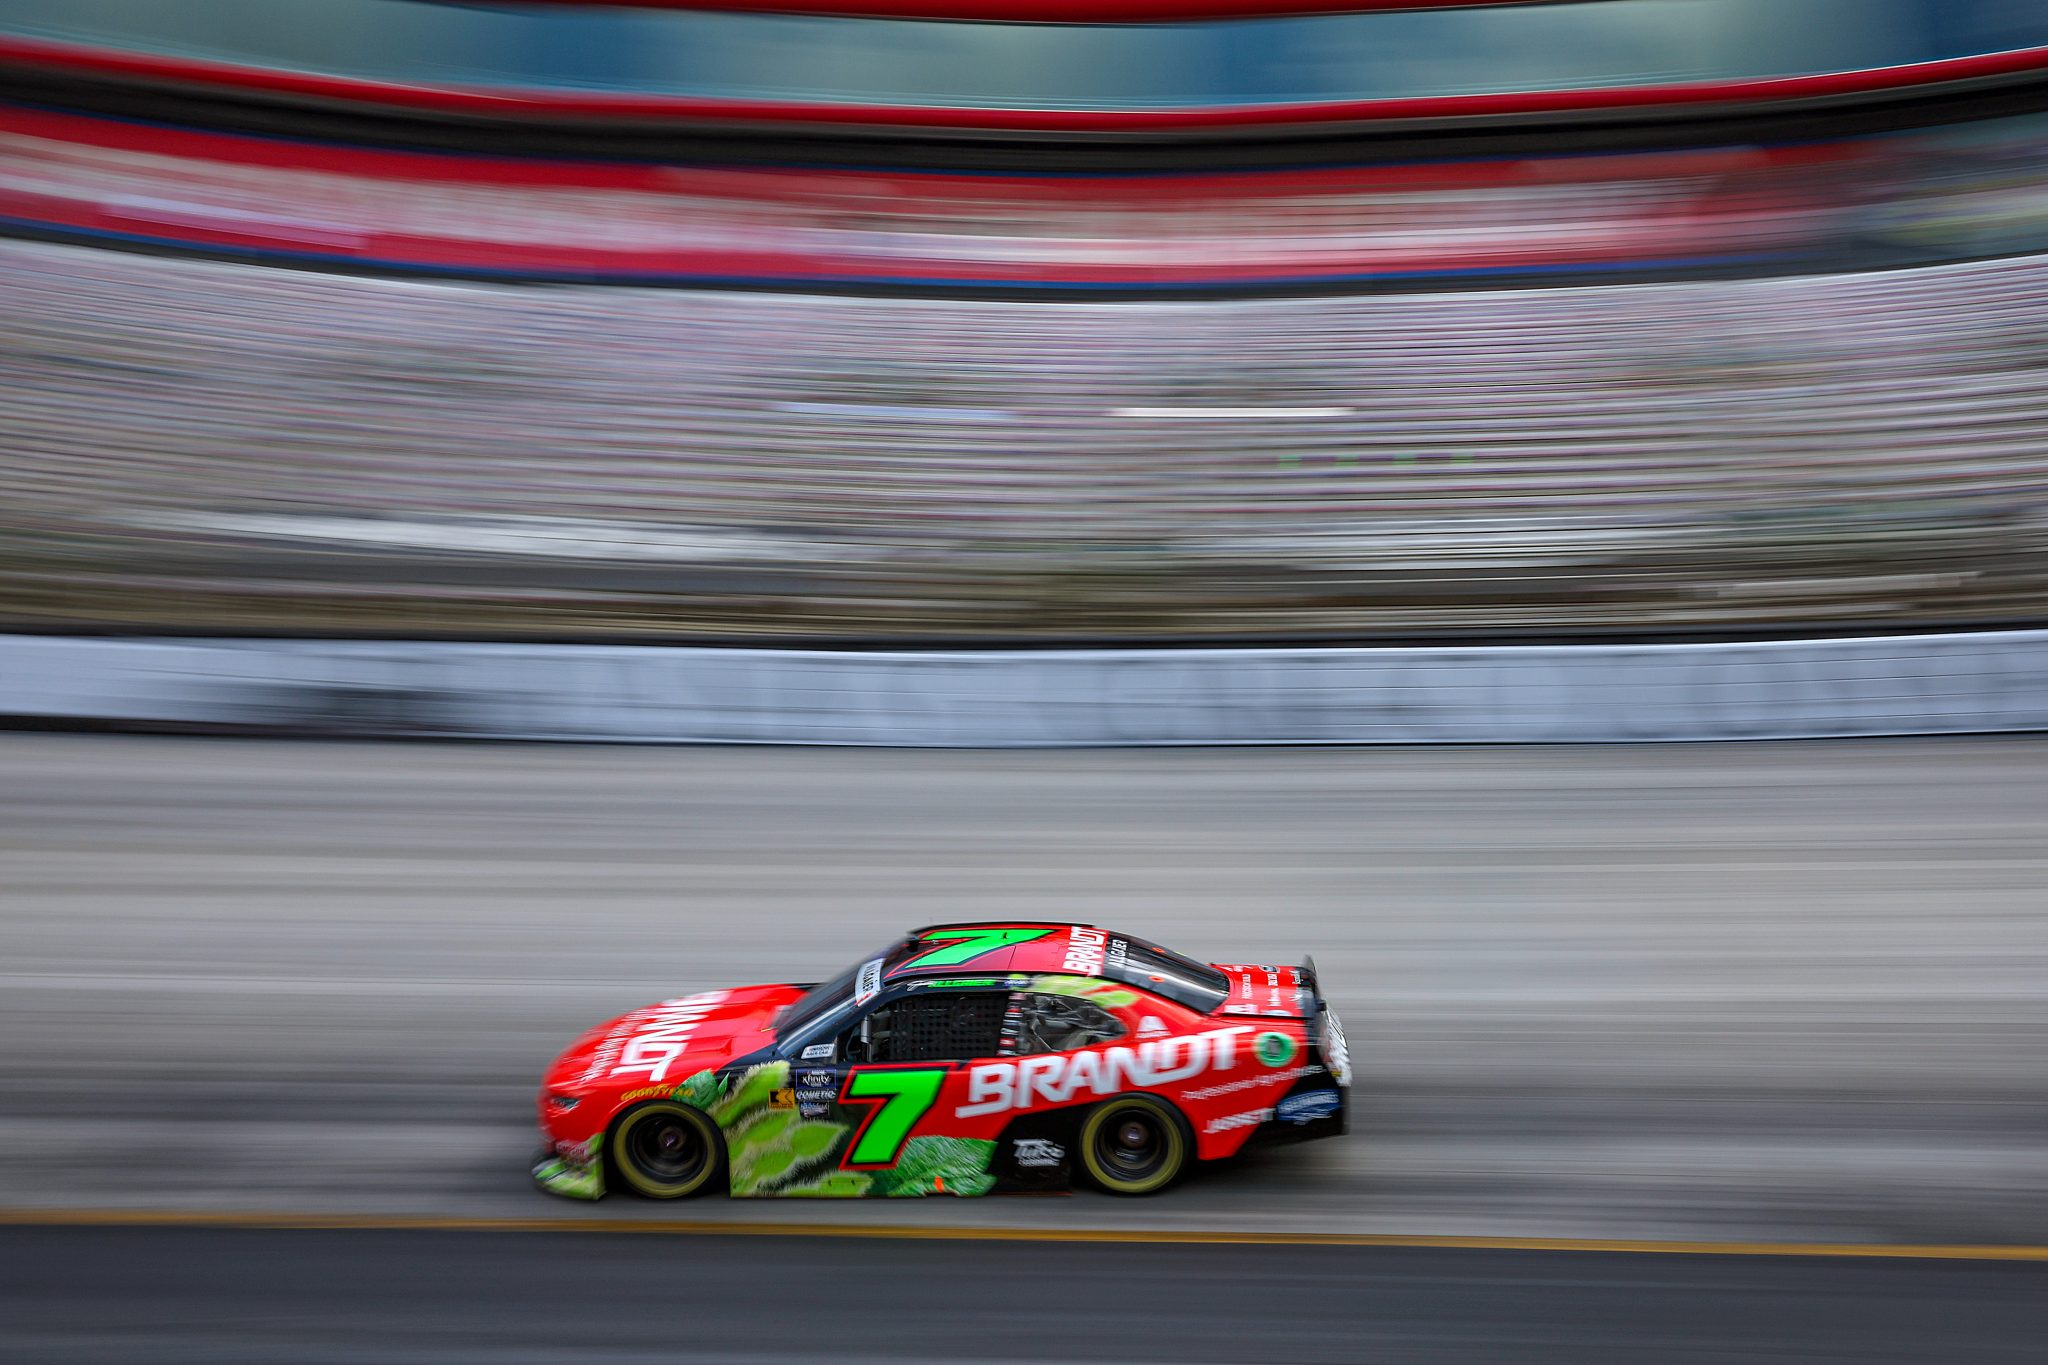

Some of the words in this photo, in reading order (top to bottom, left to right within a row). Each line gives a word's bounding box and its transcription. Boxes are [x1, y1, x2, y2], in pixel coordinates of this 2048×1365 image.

[903, 928, 1056, 970] 7
[1062, 926, 1107, 976] BRANDT
[955, 1026, 1255, 1118] BRANDT
[848, 1068, 948, 1165] 7
